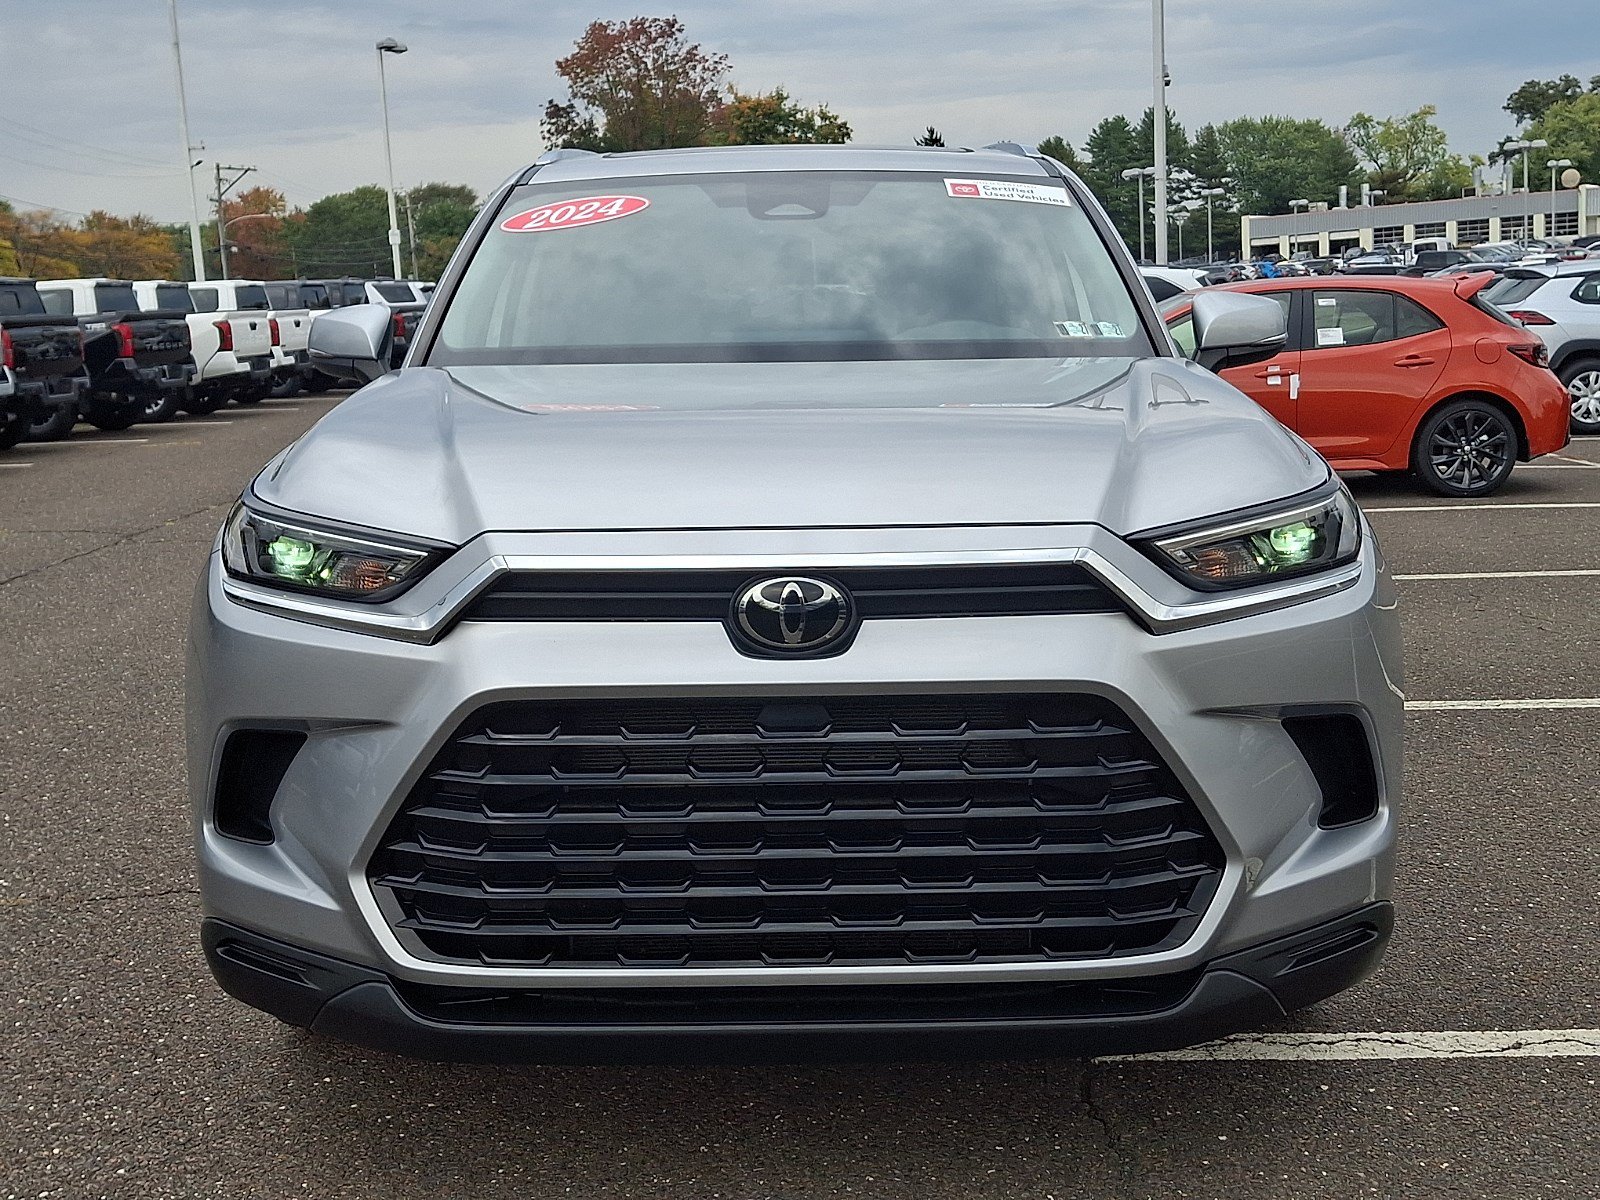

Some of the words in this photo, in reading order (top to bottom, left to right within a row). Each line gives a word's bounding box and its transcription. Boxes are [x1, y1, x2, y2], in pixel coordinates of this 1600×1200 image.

[983, 185, 1034, 195] Certified
[984, 191, 1015, 199] Used
[1017, 193, 1065, 204] Vehicles
[522, 198, 627, 230] 2024
